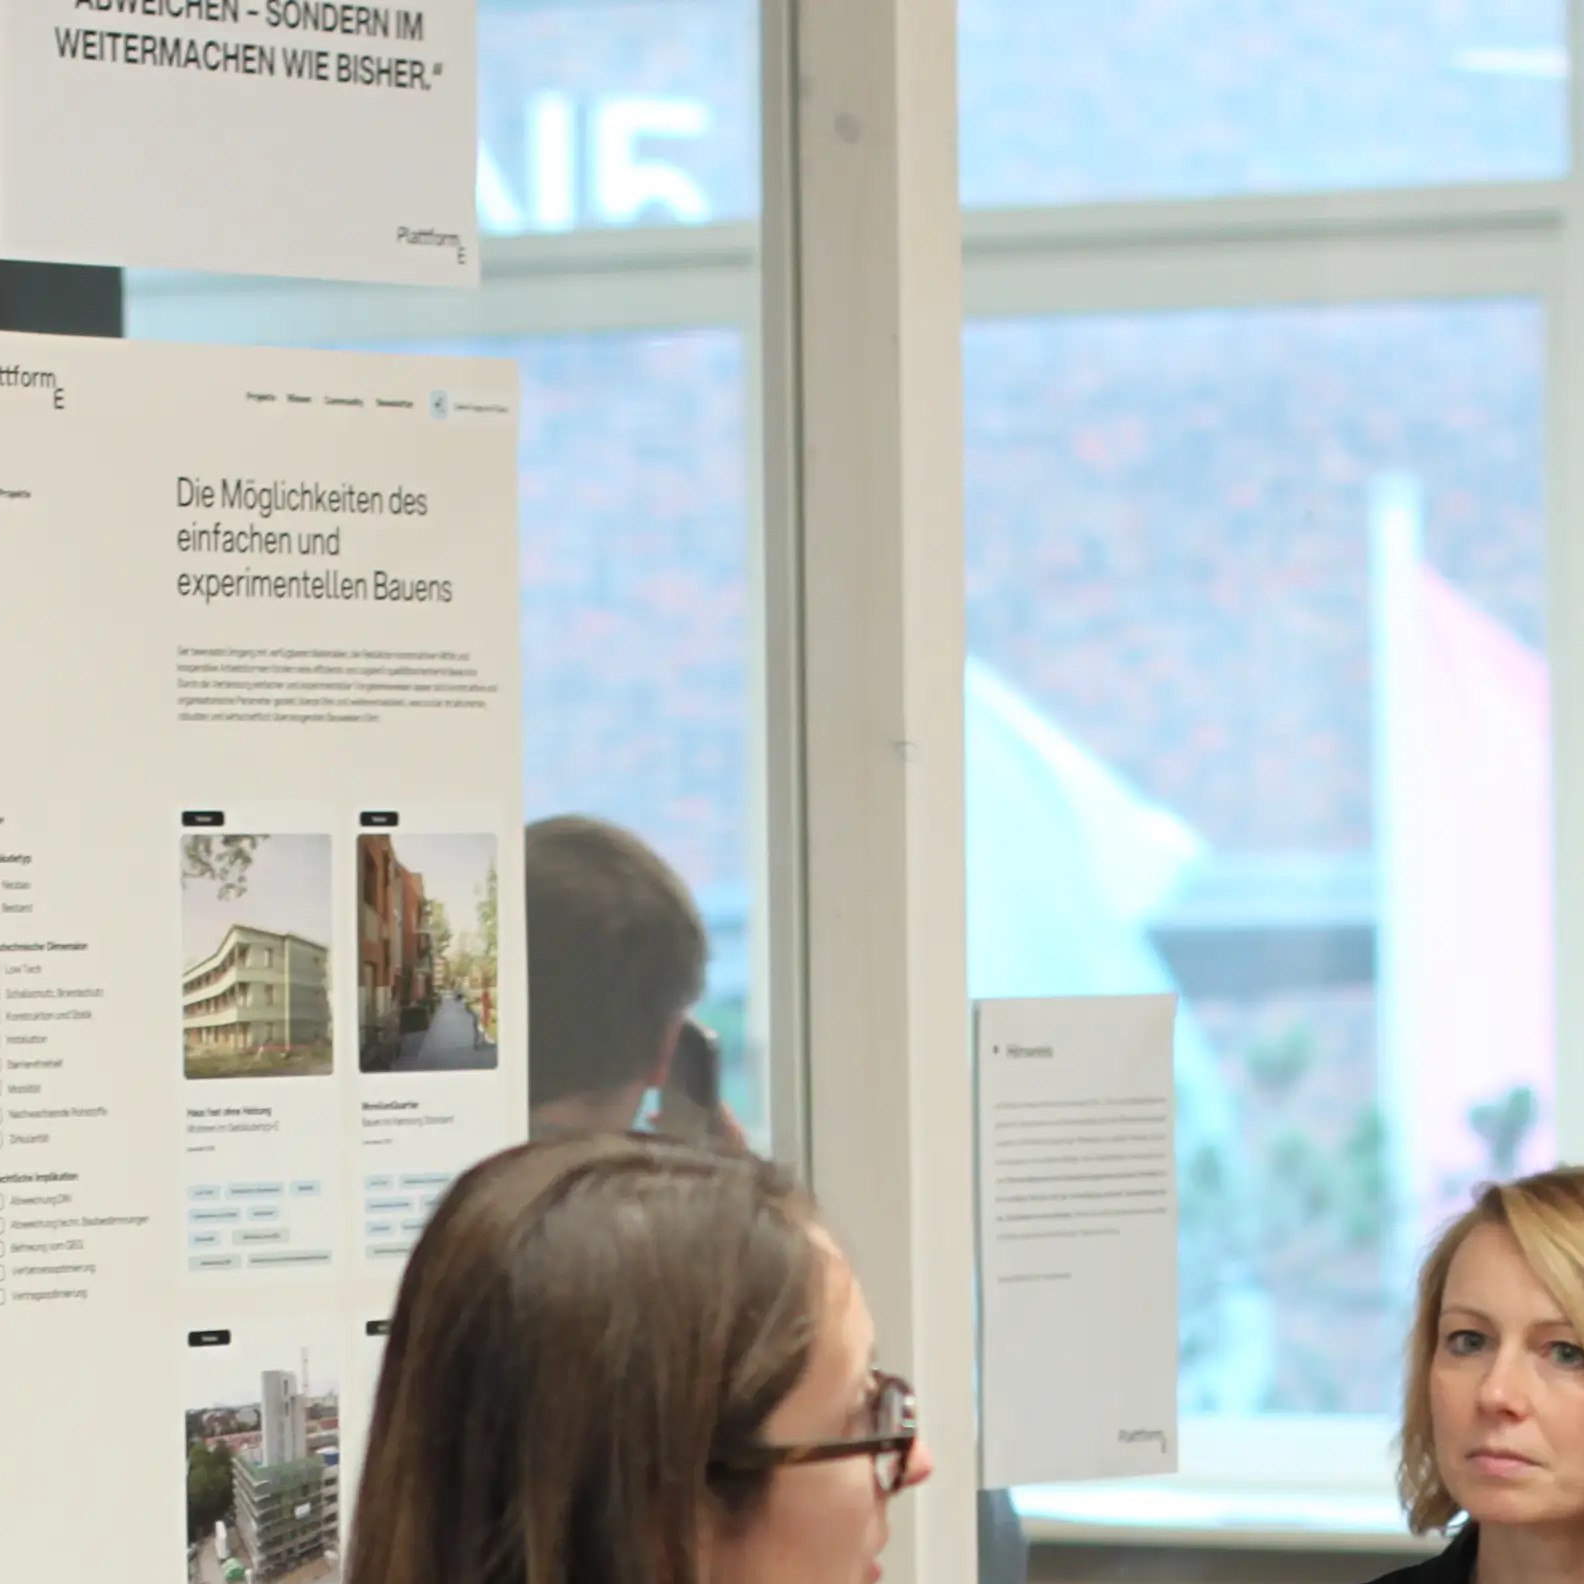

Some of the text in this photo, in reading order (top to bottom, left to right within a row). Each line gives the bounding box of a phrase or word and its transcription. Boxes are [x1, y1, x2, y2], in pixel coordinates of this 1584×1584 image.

[266, 0, 390, 38] SONDERN
[396, 10, 424, 41] IM
[55, 26, 275, 76] WEITERMACHEN
[282, 47, 329, 81] WIE
[396, 226, 458, 248] Plattform
[54, 387, 65, 410] E
[177, 476, 428, 519] Die Möglichkeiten des
[177, 521, 340, 556] einfachen und
[177, 566, 454, 605] experimentellen Bauens
